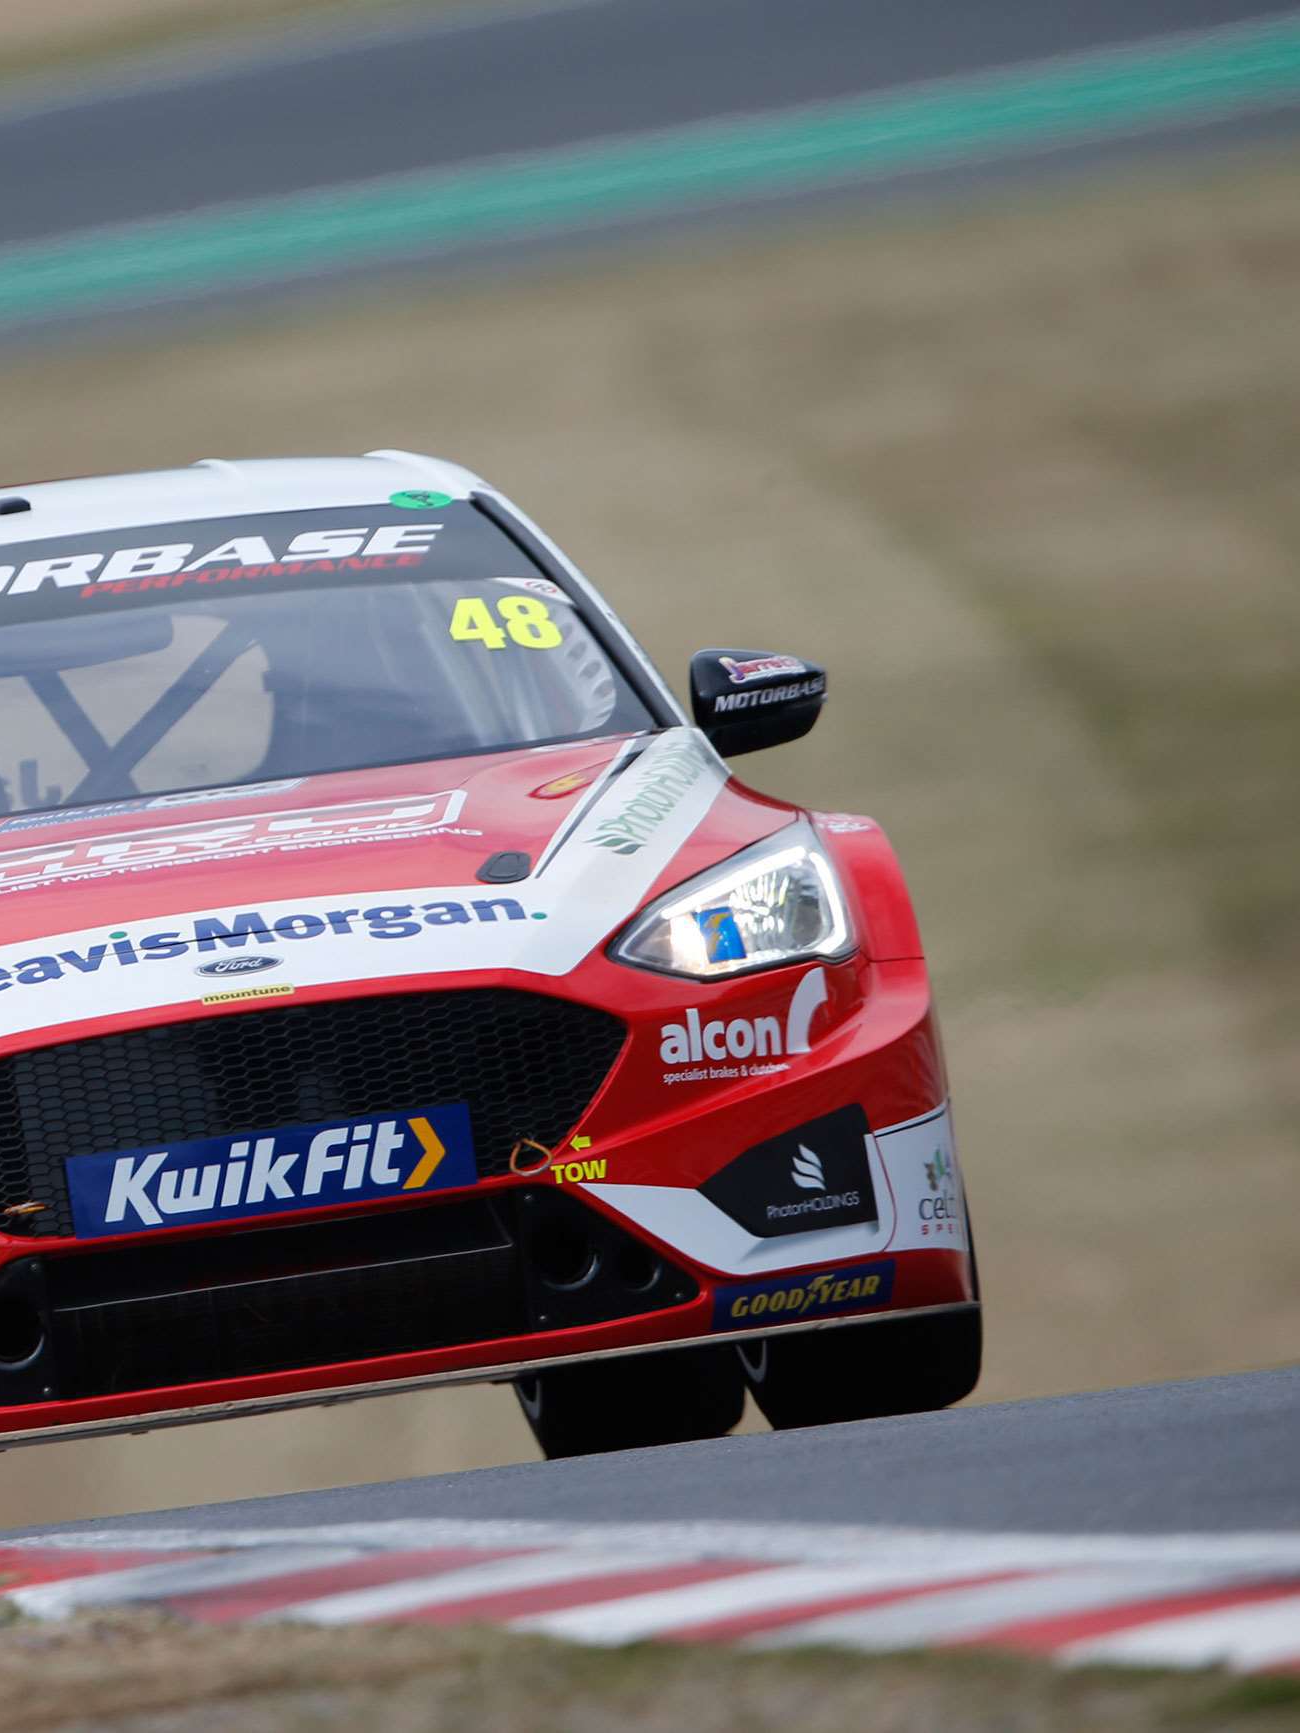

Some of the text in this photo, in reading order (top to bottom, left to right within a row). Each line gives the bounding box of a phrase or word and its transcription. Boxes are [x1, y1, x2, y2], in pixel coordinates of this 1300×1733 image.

[80, 553, 425, 598] PERFORMANCE
[449, 595, 563, 649] 48
[60, 845, 278, 884] MOTORSPORT
[279, 826, 484, 852] ENGINEERING
[214, 957, 264, 973] Ford
[203, 985, 292, 1003] mountune
[659, 1008, 782, 1064] alcon
[663, 1068, 709, 1085] specialist
[709, 1065, 739, 1079] brakes
[740, 1064, 749, 1077] &
[550, 1159, 607, 1184] TOW
[766, 1191, 860, 1220] PhotonHOLDINGS
